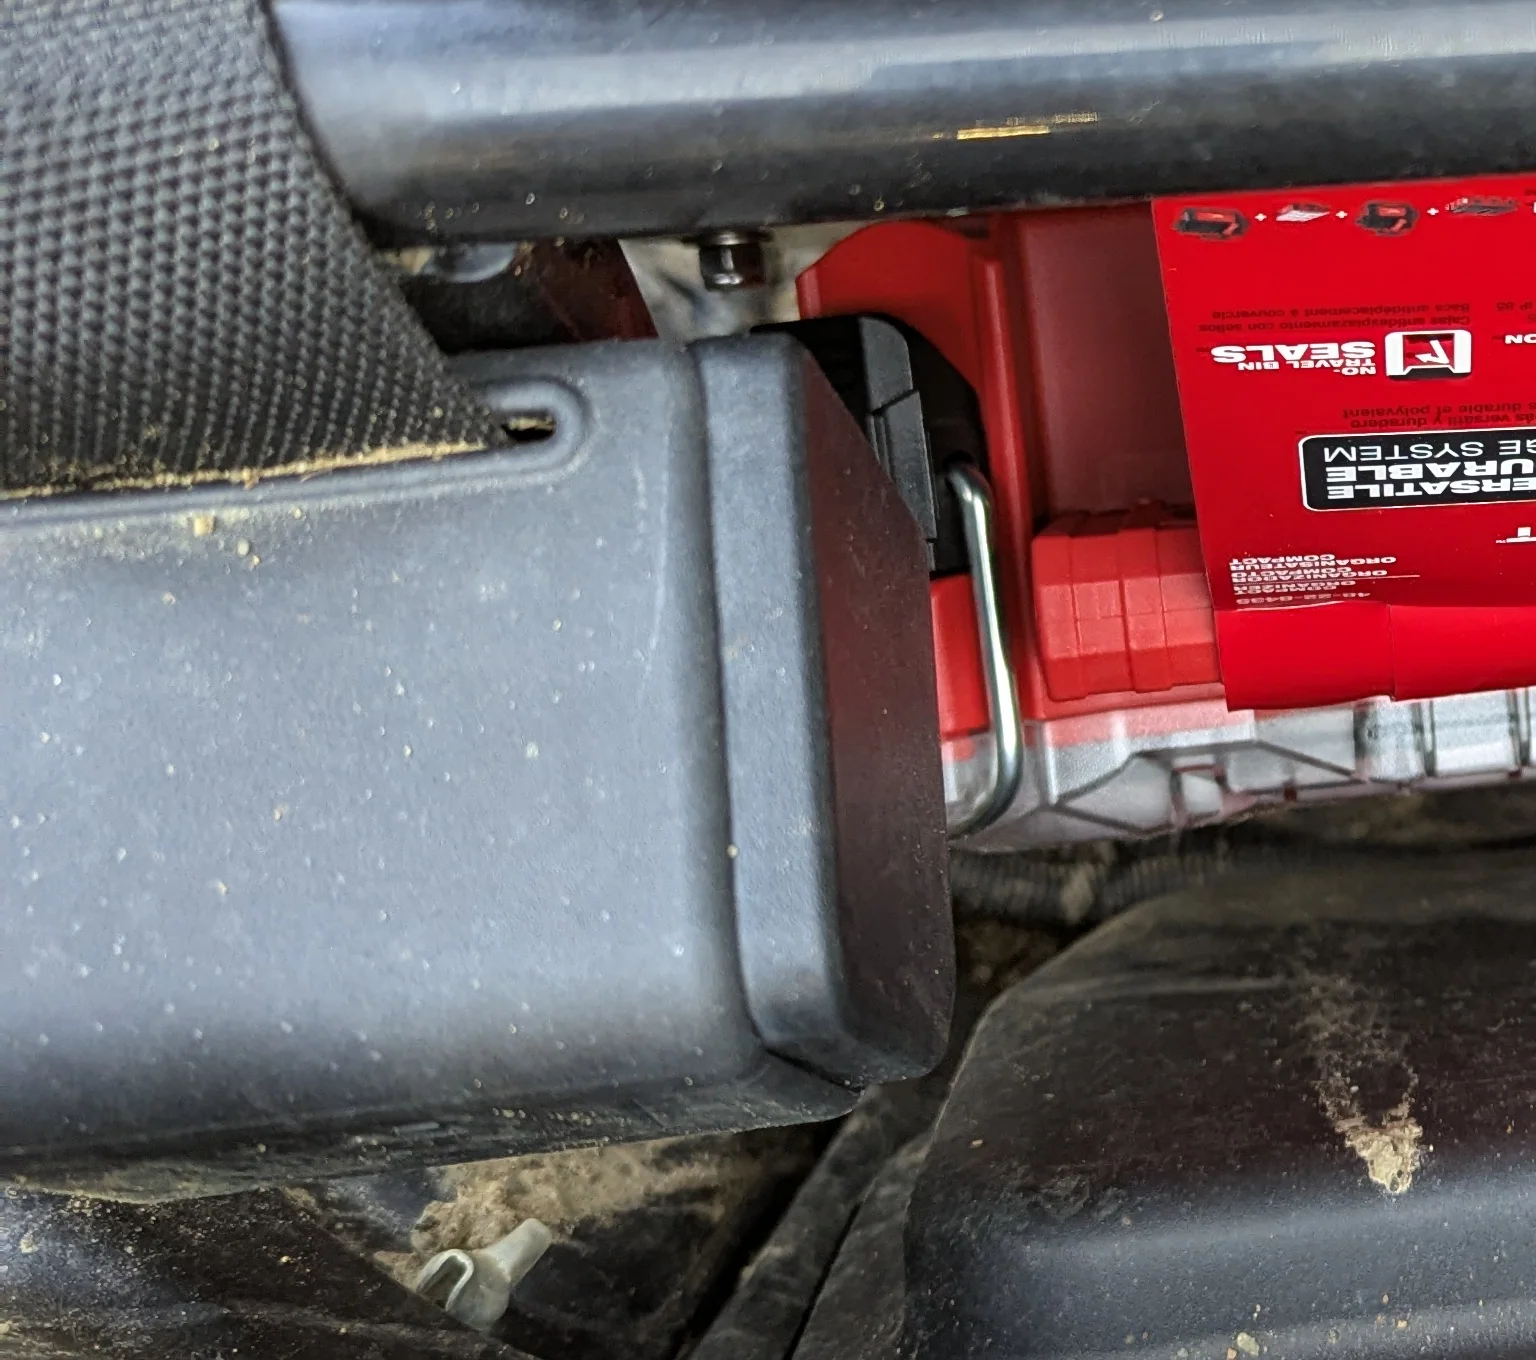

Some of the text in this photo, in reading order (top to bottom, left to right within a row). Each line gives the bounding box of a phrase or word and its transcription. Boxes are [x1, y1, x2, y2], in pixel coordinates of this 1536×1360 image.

[1210, 341, 1376, 363] SEALS
[1237, 358, 1375, 370] TRAVEL BIN
[1333, 366, 1377, 375] NO-
[1342, 405, 1431, 420] polyvalent
[1457, 401, 1521, 417] durable
[1350, 417, 1428, 430] duradero
[1323, 441, 1485, 463] SYSTEM
[1229, 554, 1335, 566] COMPACT
[1230, 556, 1396, 570] ORGANISATEUR
[1231, 567, 1352, 577] COMPACTO
[1231, 570, 1387, 582] ORGANIZADOR
[1233, 580, 1355, 591] ORGANIZER
[1234, 585, 1336, 595] COMPACT
